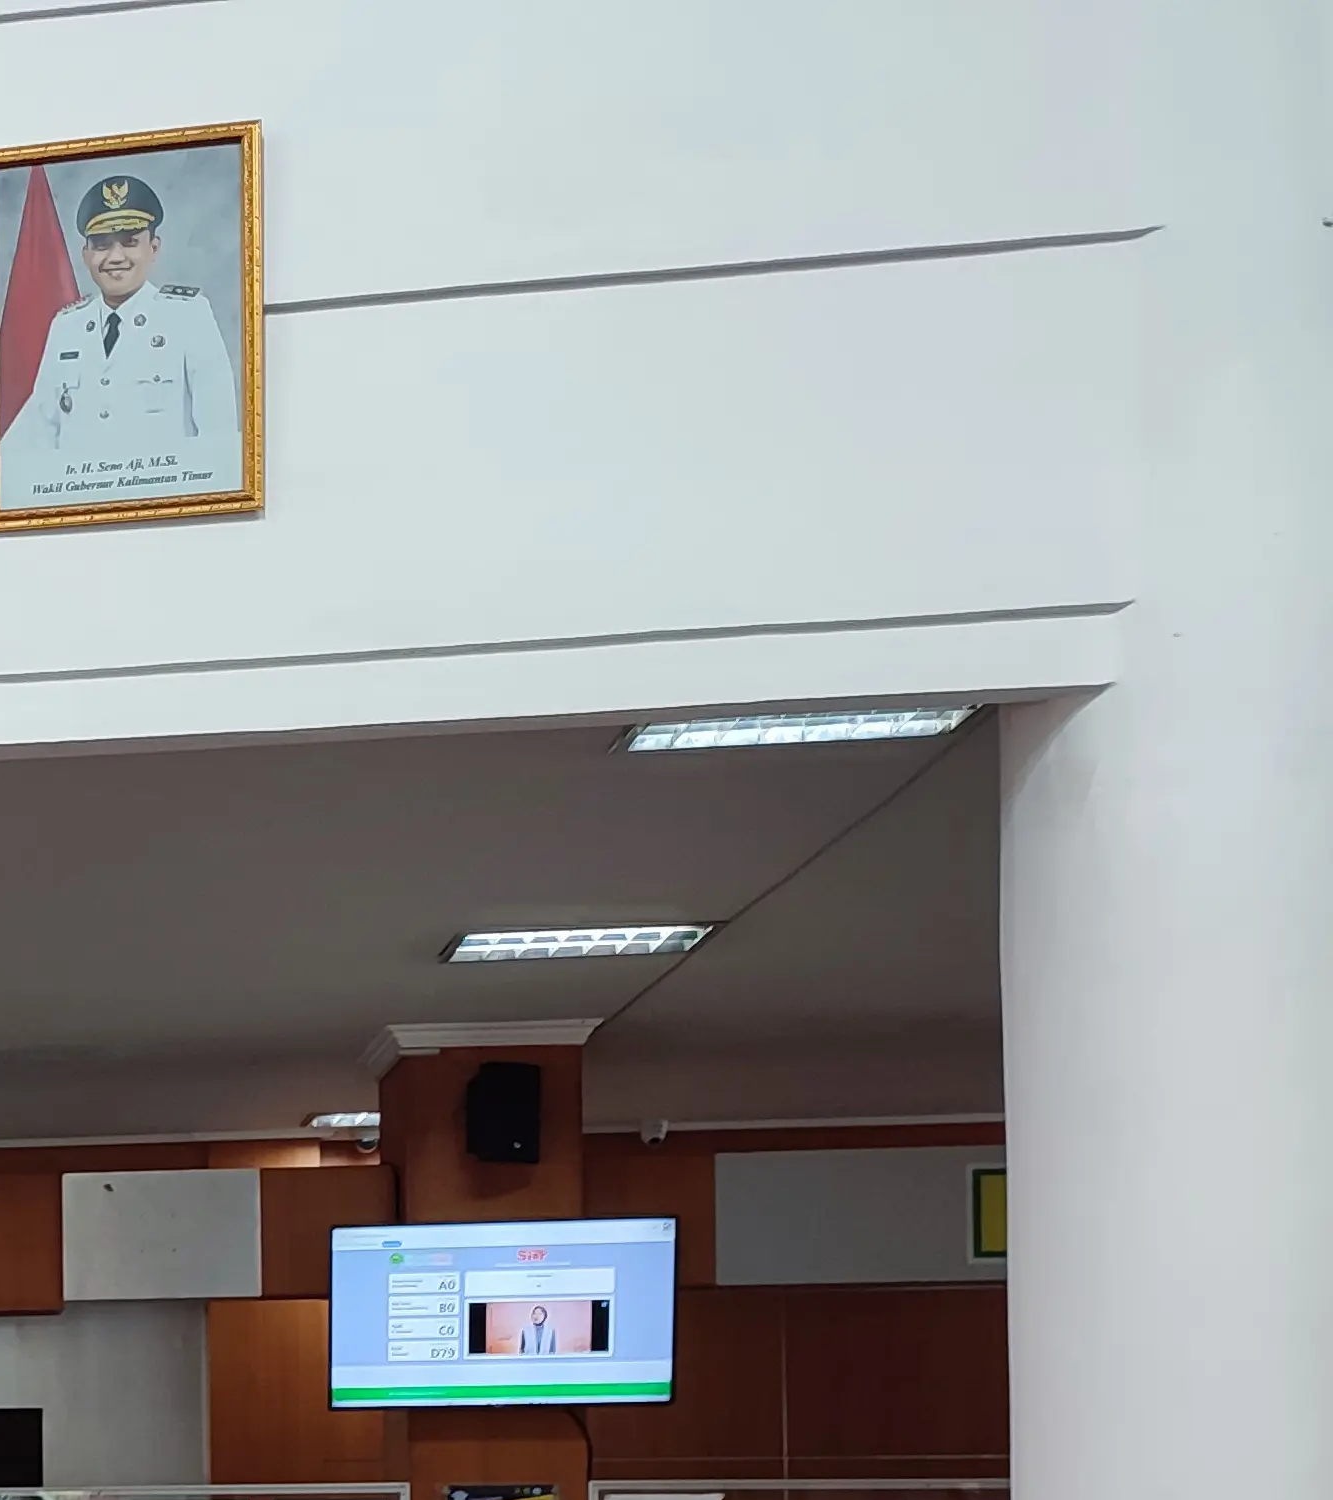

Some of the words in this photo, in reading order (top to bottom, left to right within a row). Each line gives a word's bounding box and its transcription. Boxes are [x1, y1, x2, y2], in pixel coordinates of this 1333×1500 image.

[81, 462, 94, 474] H.
[97, 461, 123, 473] Seno
[32, 482, 63, 496] Wakil
[65, 479, 115, 493] Gubernur
[117, 474, 178, 488] Kalimantan
[182, 470, 214, 482] Timur
[438, 1279, 456, 1291] A0
[438, 1325, 456, 1337] C0
[430, 1347, 457, 1359] D79
